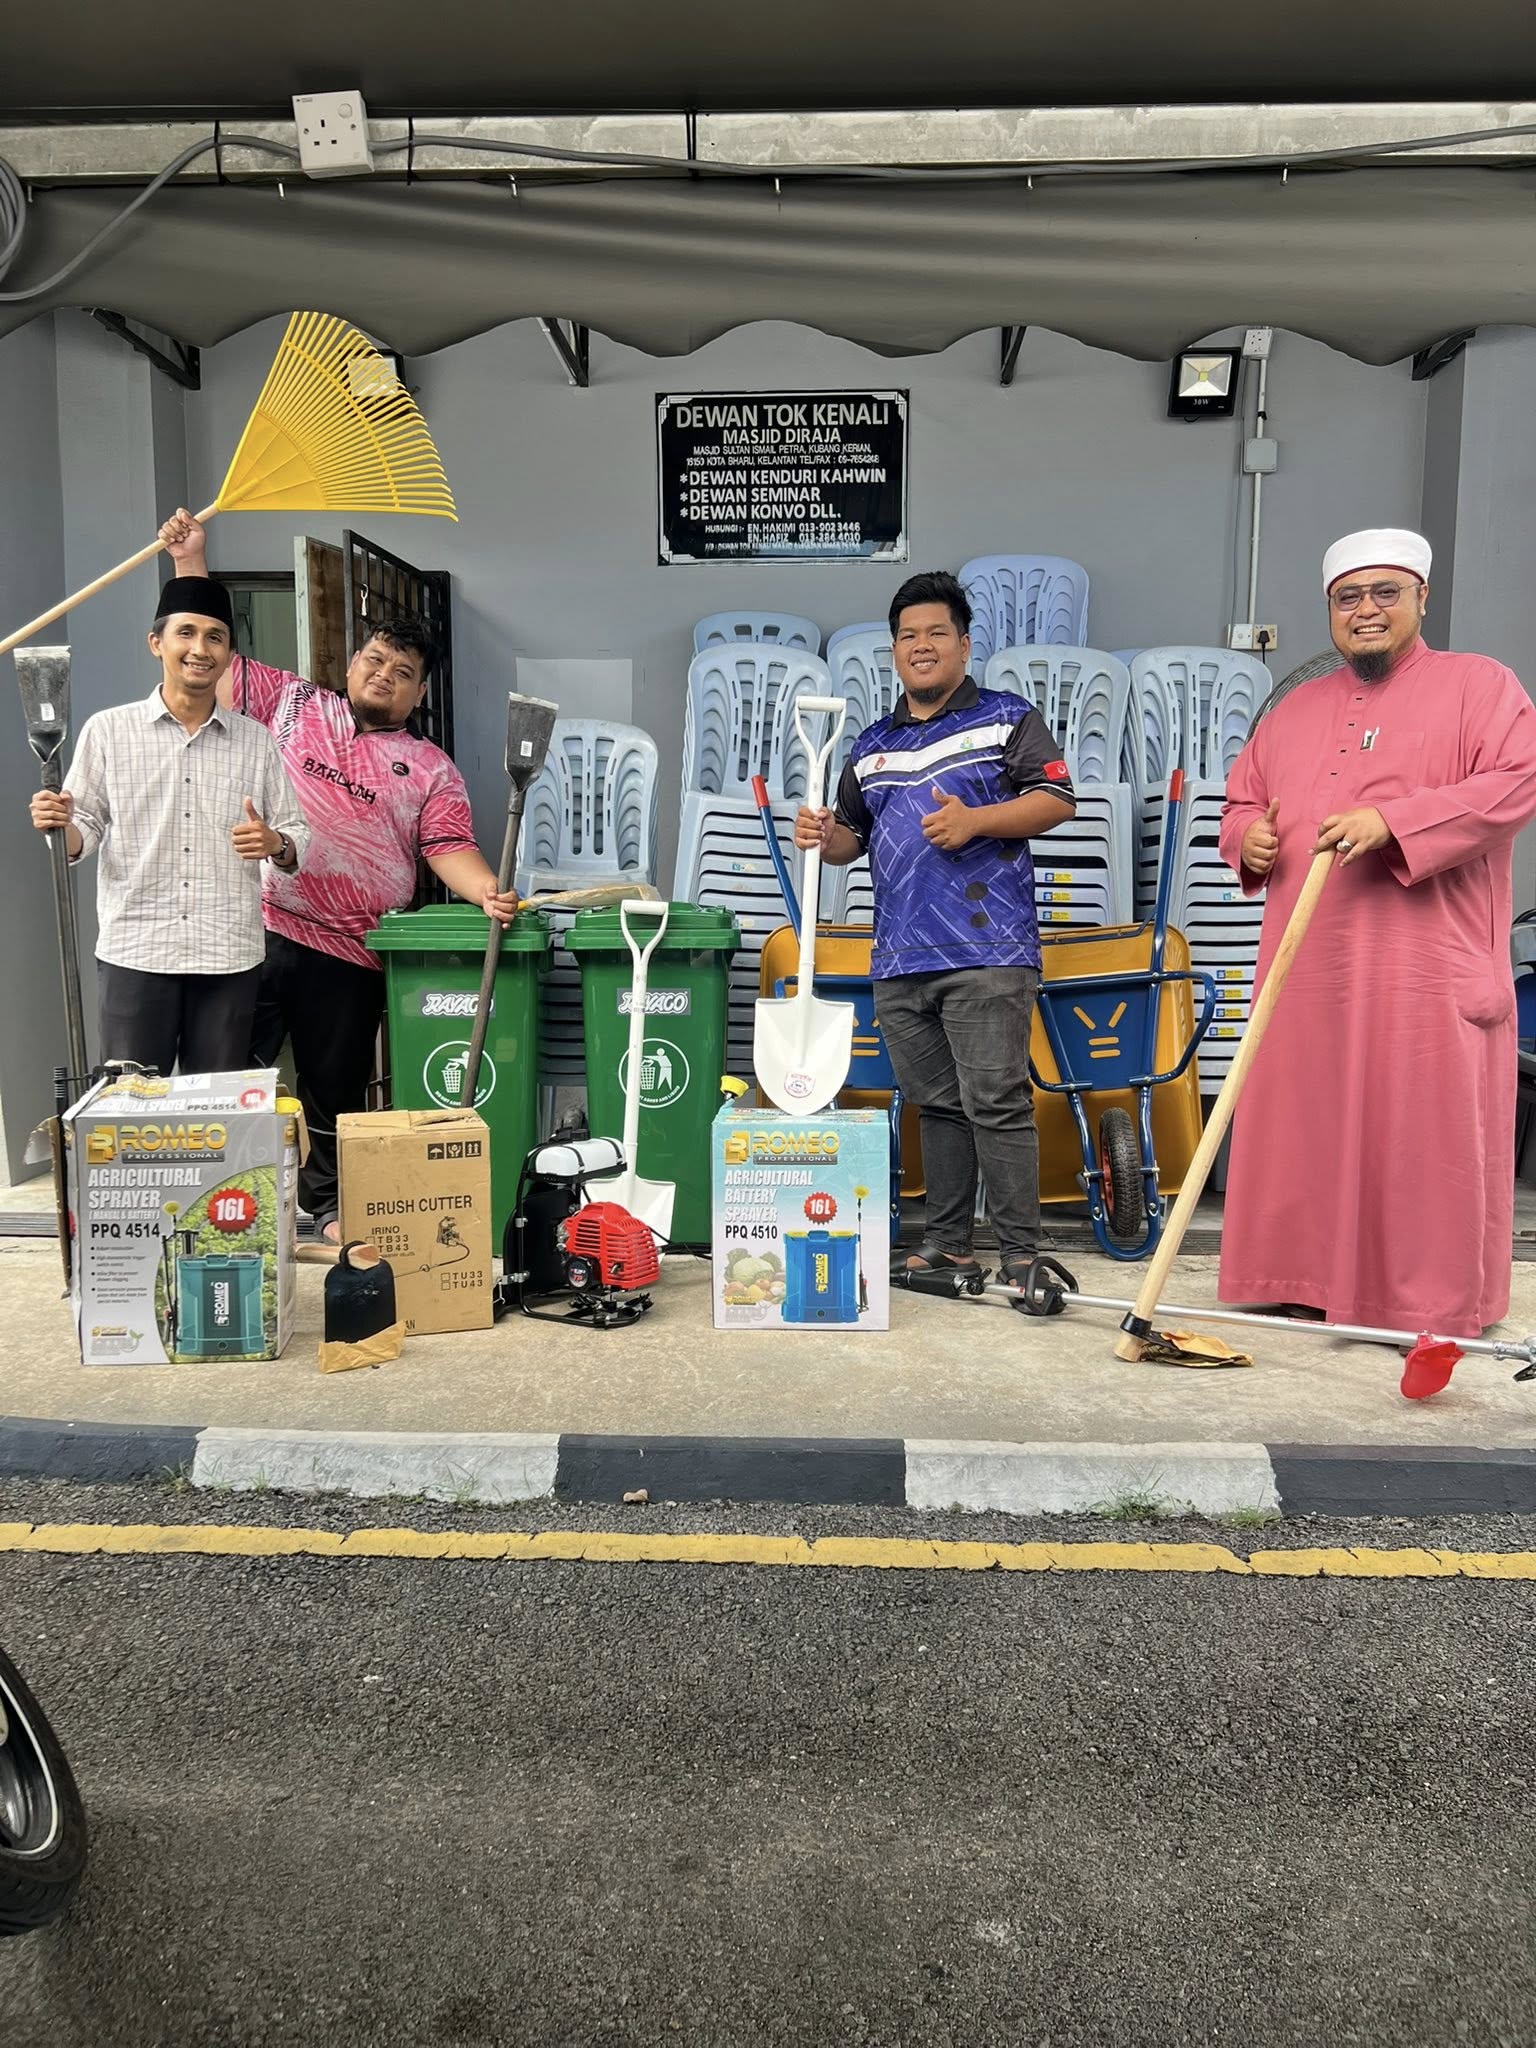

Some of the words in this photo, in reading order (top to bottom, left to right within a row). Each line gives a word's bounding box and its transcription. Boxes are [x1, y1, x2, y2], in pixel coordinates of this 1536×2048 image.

[676, 405, 758, 428] DEWAN
[763, 404, 808, 426] TOK
[813, 403, 889, 425] KENALI
[723, 429, 782, 444] MASJID
[785, 428, 842, 443] DIRAJA
[693, 446, 720, 455] MASJID
[723, 445, 750, 455] SULTAN
[752, 445, 776, 454] ISMAIL
[779, 444, 806, 455] PETRA,
[808, 444, 840, 454] KUBANG
[707, 457, 726, 466] KOTA
[757, 455, 797, 465] KELANTAN
[800, 455, 831, 464] TEL/FAX
[751, 469, 817, 485] KENDURI
[821, 468, 886, 483] KAHWIN
[751, 487, 821, 502] SEMINAR
[751, 503, 806, 519] KONVO
[810, 503, 841, 519] DLL.
[705, 524, 738, 533] HUBUNGI
[422, 994, 494, 1016] RAYAC
[211, 1103, 237, 1111] 4514
[120, 1123, 227, 1150] ROMEO
[753, 1130, 840, 1154] ROMEO
[127, 1152, 219, 1160] PROFESSIONAL
[88, 1168, 202, 1187] AGRICULTURAL
[724, 1170, 814, 1187] AGRICULTURAL
[88, 1190, 161, 1209] SPRAYER
[724, 1188, 778, 1205] BATTERY
[215, 1197, 246, 1222] 16L
[367, 1199, 415, 1217] BRUSH
[419, 1195, 472, 1212] CUTTER
[809, 1198, 832, 1215] 16L
[724, 1207, 778, 1223] SPRAYER
[91, 1223, 121, 1239] PPQ
[125, 1223, 160, 1238] 4514
[372, 1225, 400, 1235] IRINO
[725, 1225, 748, 1240] PPQ
[751, 1225, 778, 1239] 4510
[816, 1253, 825, 1283] ROMEO
[214, 1281, 225, 1315] ROMEO
